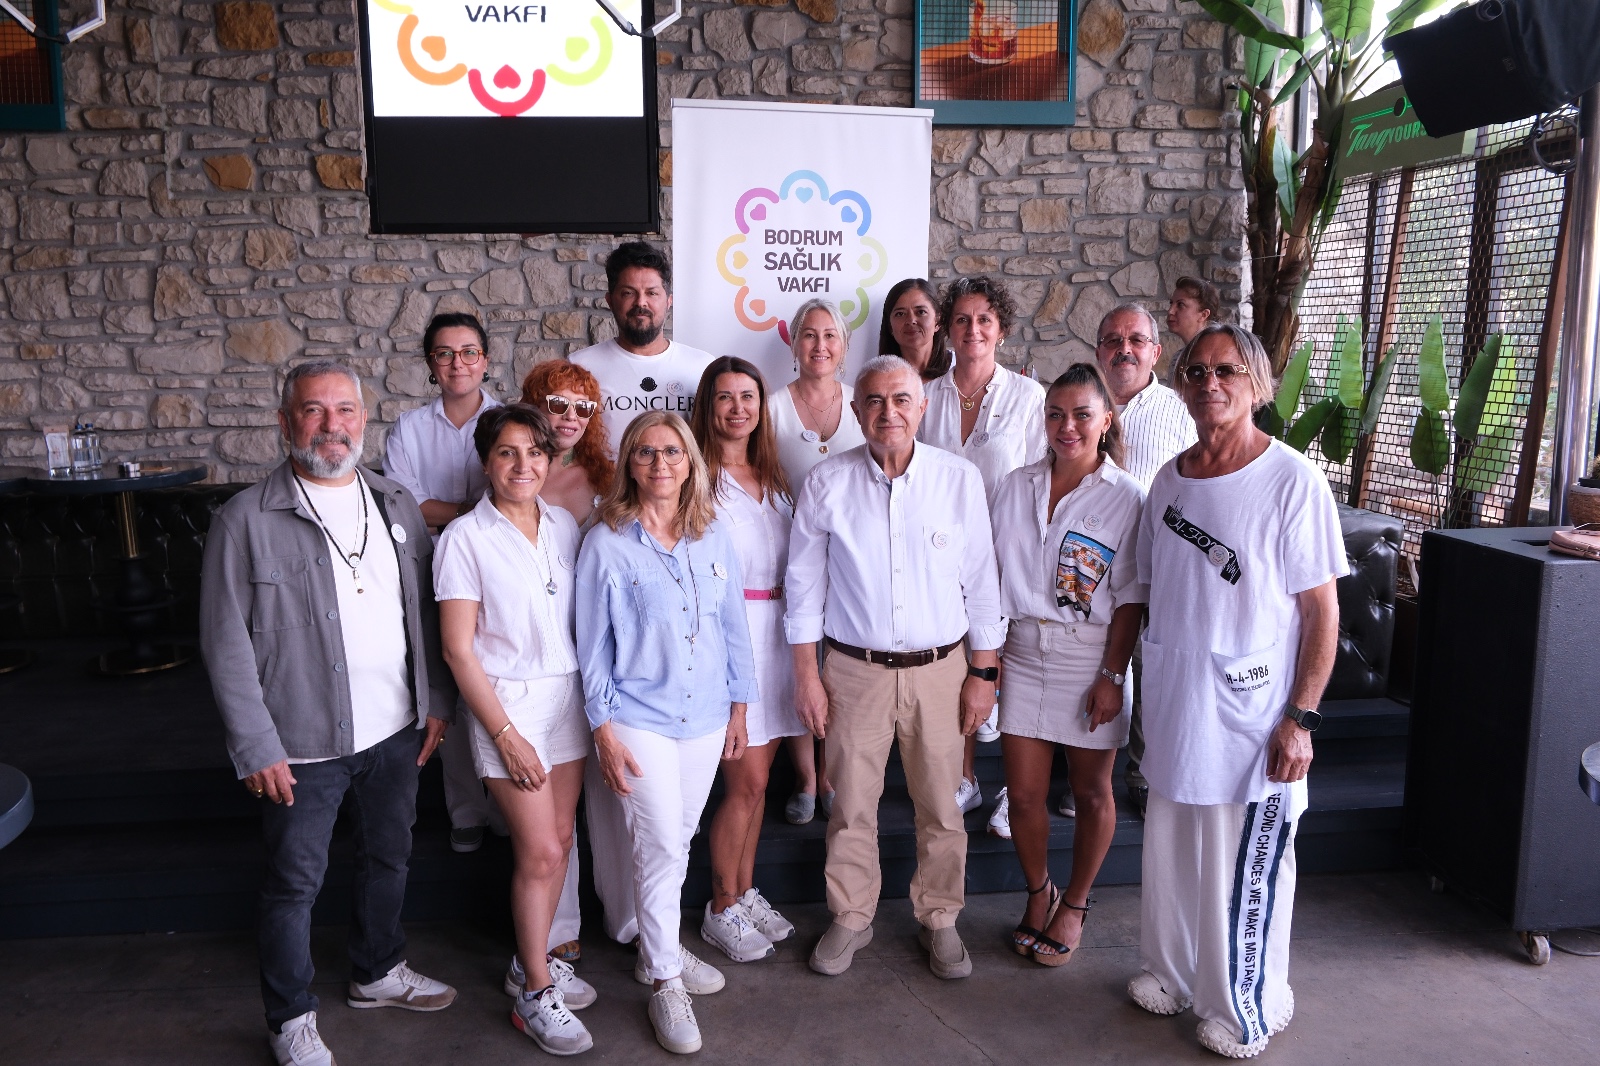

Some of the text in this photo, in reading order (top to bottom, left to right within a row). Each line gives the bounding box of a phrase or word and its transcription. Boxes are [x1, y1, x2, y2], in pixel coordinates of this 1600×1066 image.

[465, 5, 546, 22] VAKFI
[764, 229, 842, 246] BODRUM
[764, 247, 842, 271] SAĞLIK
[777, 276, 830, 292] VAKFI
[1251, 835, 1270, 886] CHANCES
[1248, 888, 1261, 906] WE
[1244, 908, 1260, 940] MAKE
[1241, 942, 1256, 996] MISTAKES
[1242, 997, 1256, 1019] WE
